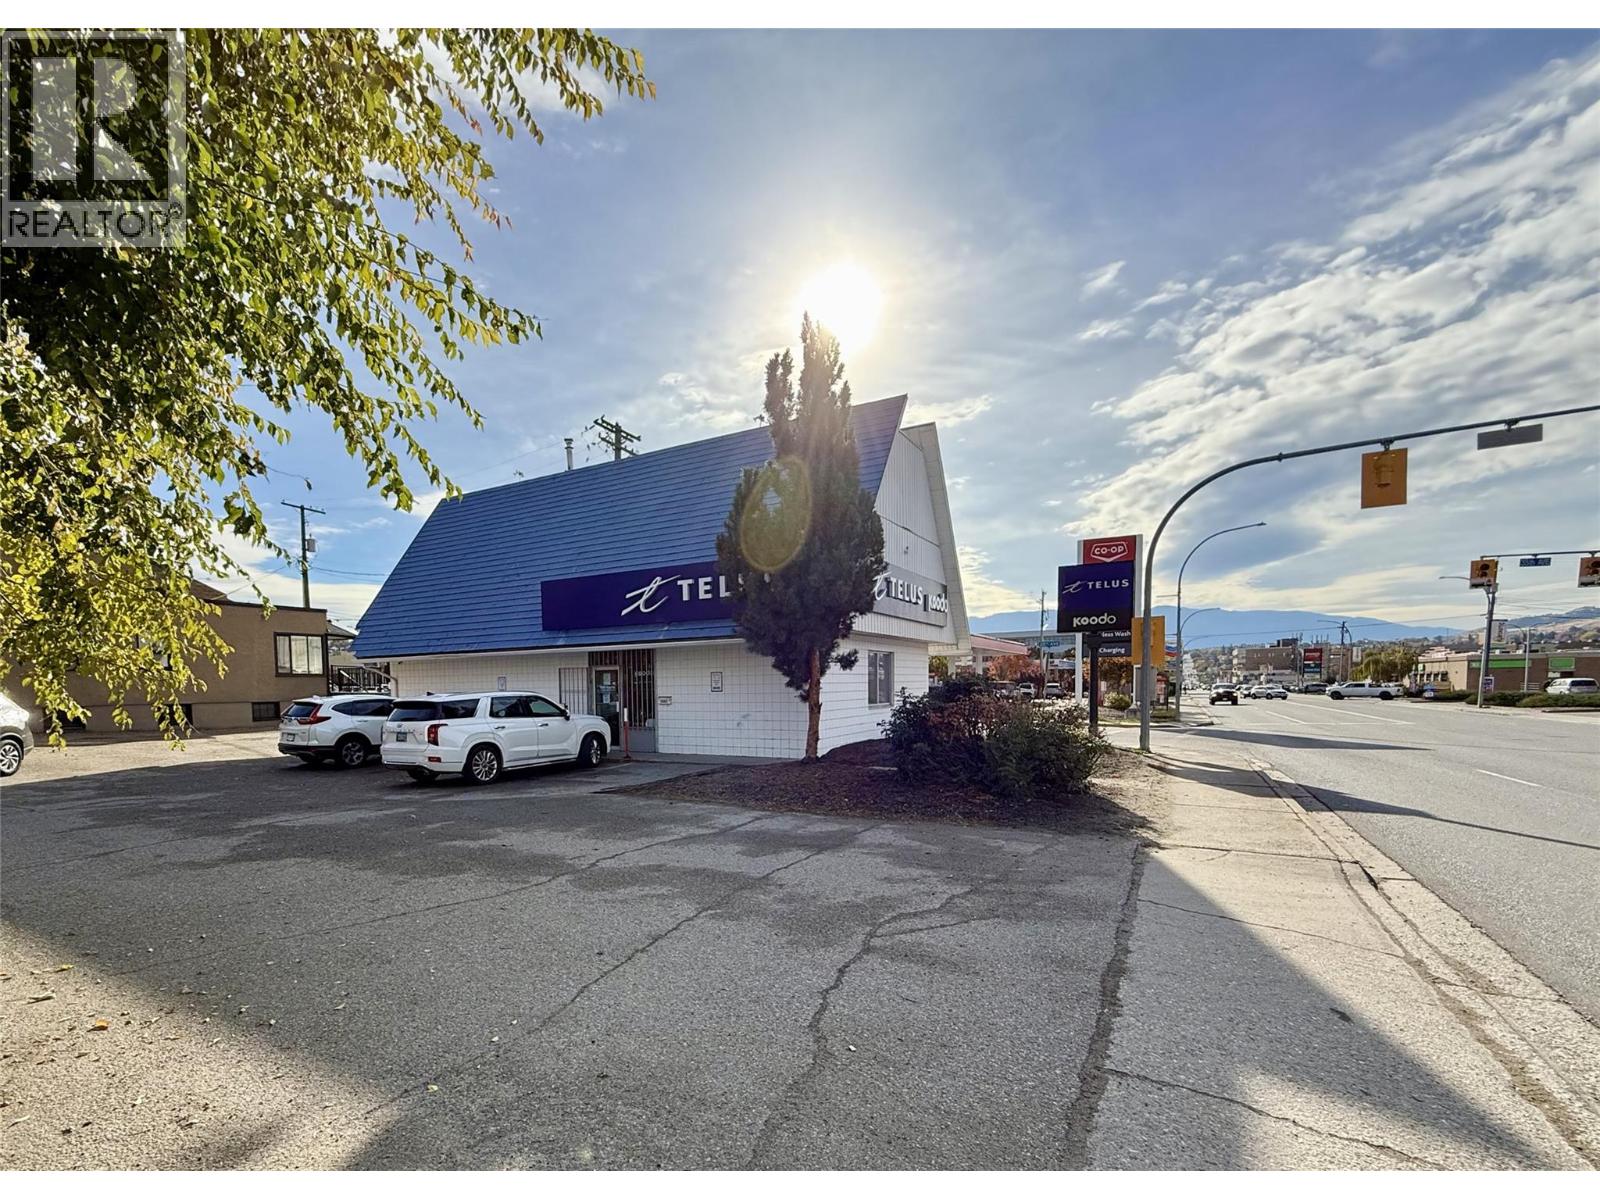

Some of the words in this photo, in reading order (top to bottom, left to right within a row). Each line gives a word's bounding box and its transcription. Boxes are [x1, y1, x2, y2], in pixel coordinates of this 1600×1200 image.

[1094, 545, 1124, 555] CO-OP
[1087, 579, 1129, 590] TELUS
[890, 577, 924, 605] TELUS
